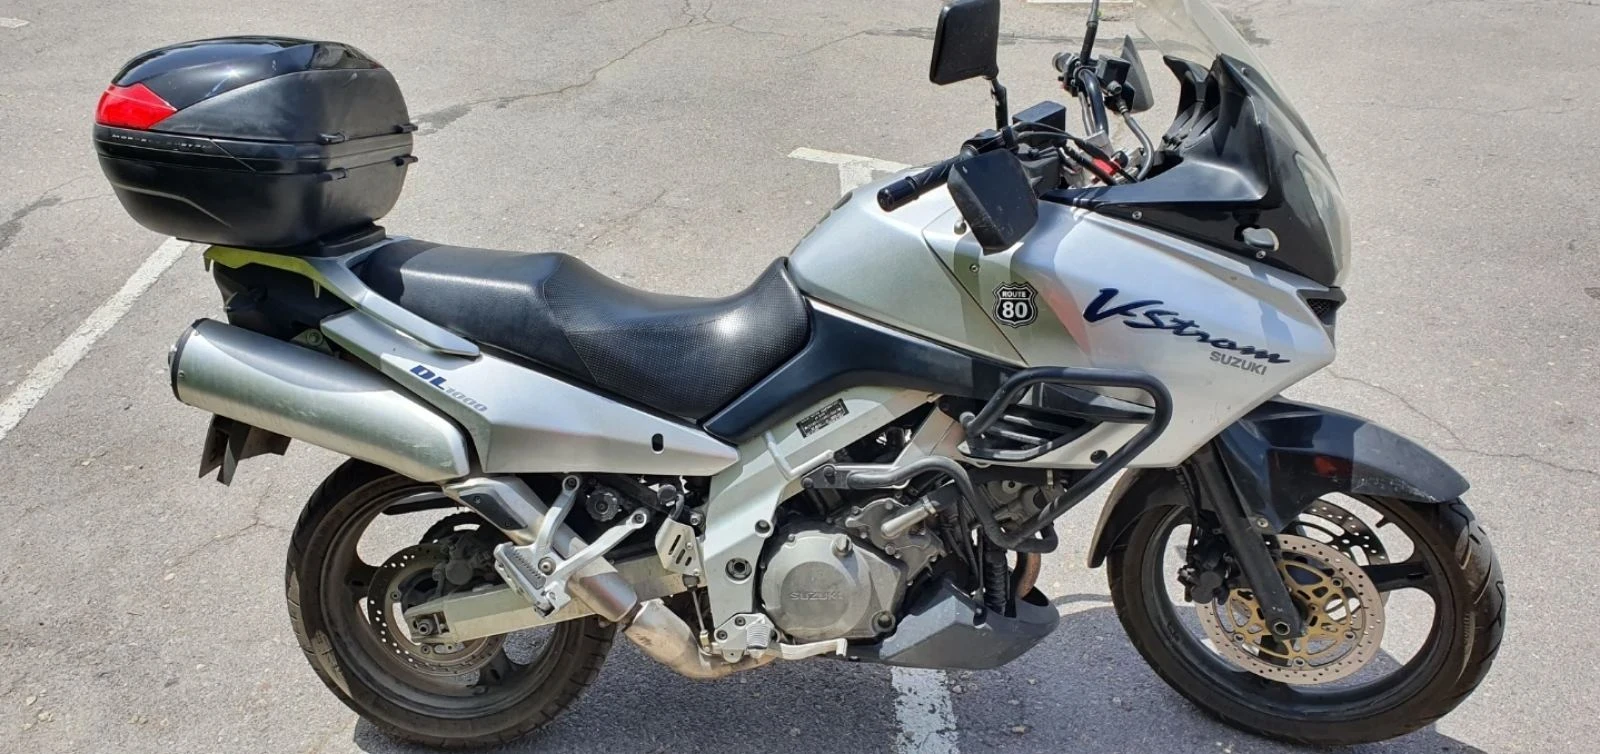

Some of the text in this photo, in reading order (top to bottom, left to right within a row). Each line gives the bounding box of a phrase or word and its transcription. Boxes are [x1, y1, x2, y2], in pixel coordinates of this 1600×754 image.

[1002, 290, 1027, 298] ROUTE
[1002, 301, 1028, 319] 80
[1209, 350, 1268, 376] SUZUKI
[790, 591, 844, 601] SUZUKI
